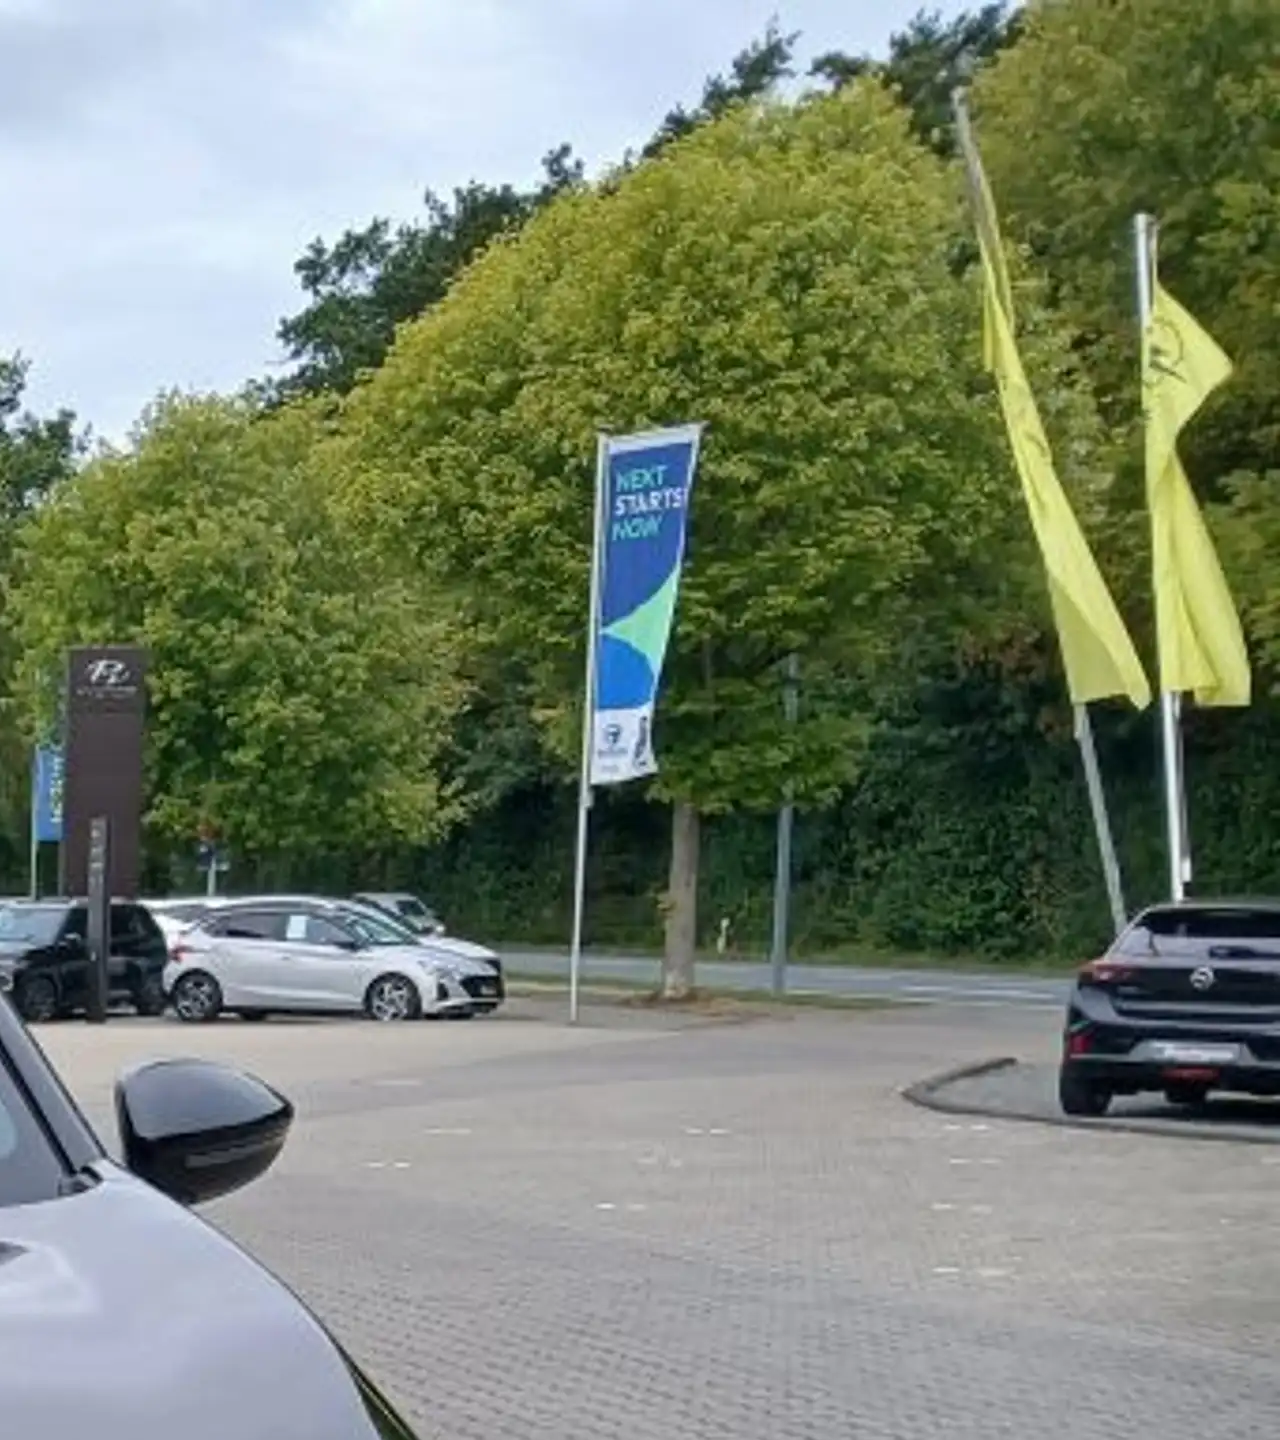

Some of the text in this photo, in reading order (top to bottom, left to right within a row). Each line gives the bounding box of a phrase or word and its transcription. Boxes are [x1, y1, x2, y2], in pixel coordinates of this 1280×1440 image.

[615, 465, 667, 492] NEXT
[614, 487, 685, 516] STARTS
[611, 515, 663, 541] NOW
